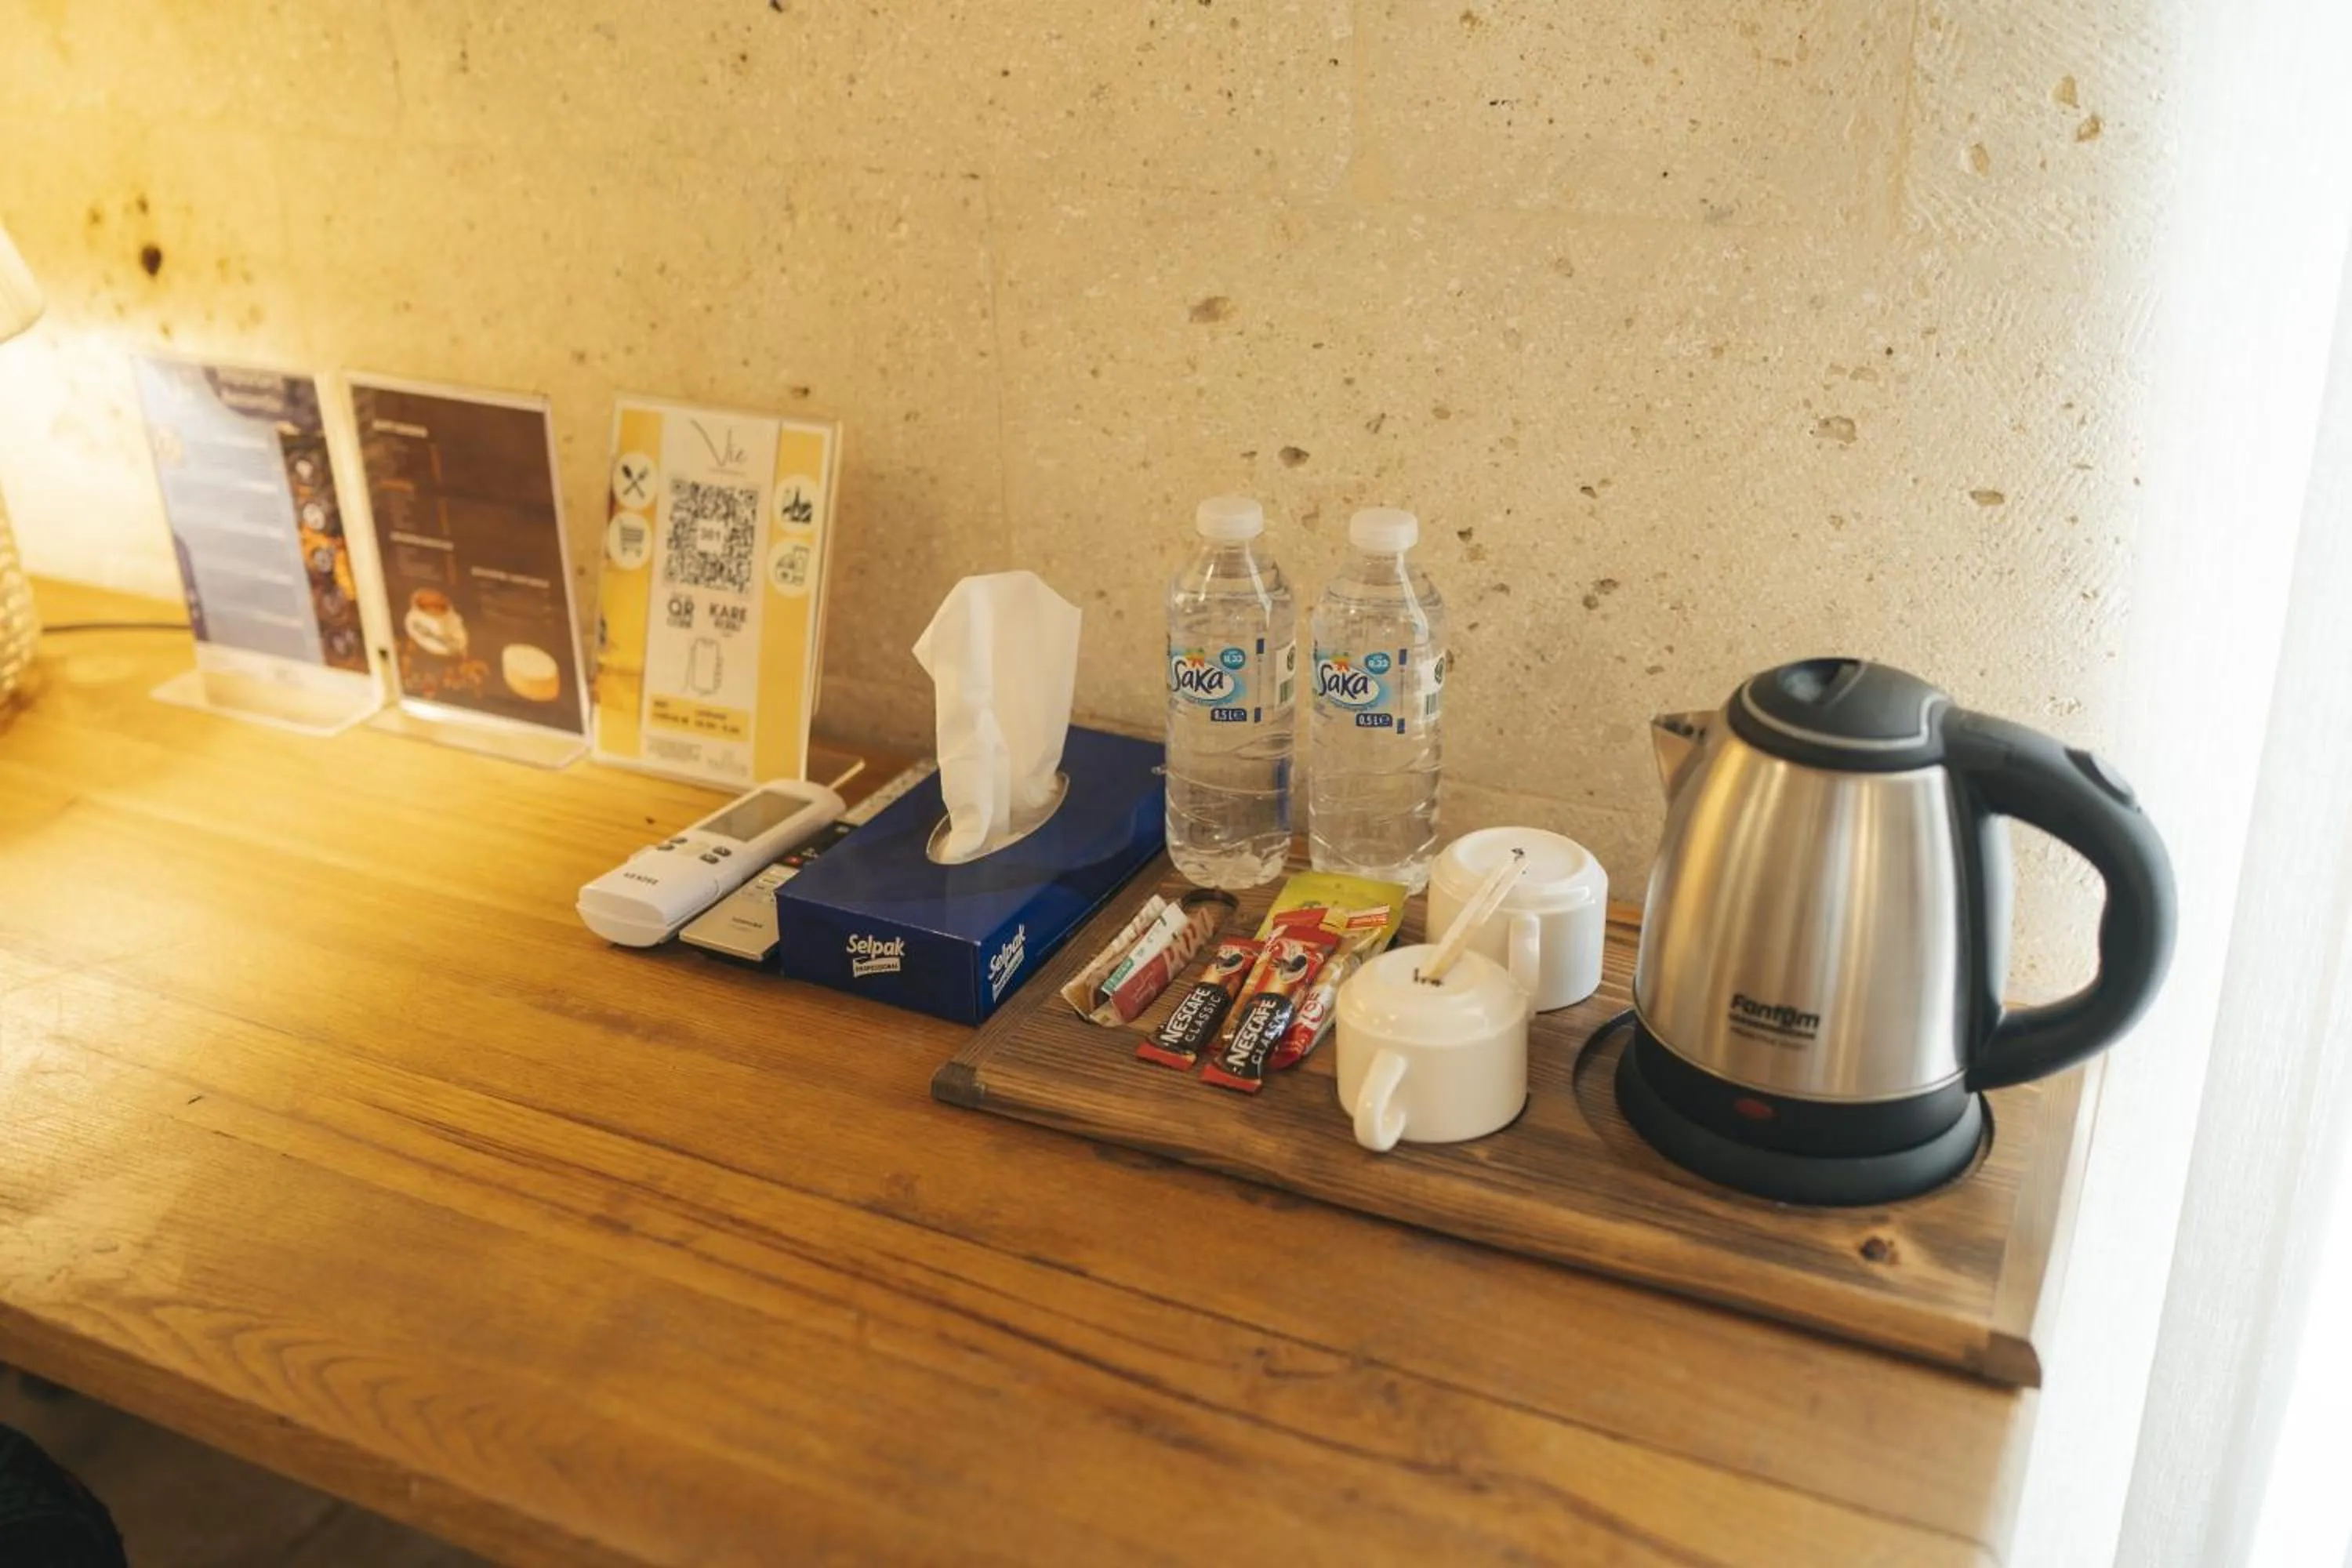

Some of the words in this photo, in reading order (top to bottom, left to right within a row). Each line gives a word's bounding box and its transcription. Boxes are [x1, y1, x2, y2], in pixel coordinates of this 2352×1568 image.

[667, 599, 695, 618] QR
[1172, 660, 1225, 694] Saka
[1319, 664, 1369, 699] Saka
[846, 934, 906, 959] Selpak
[988, 924, 1026, 981] Selpak
[1185, 994, 1221, 1043] CLASSIC
[1251, 1009, 1285, 1065] CLASSIC
